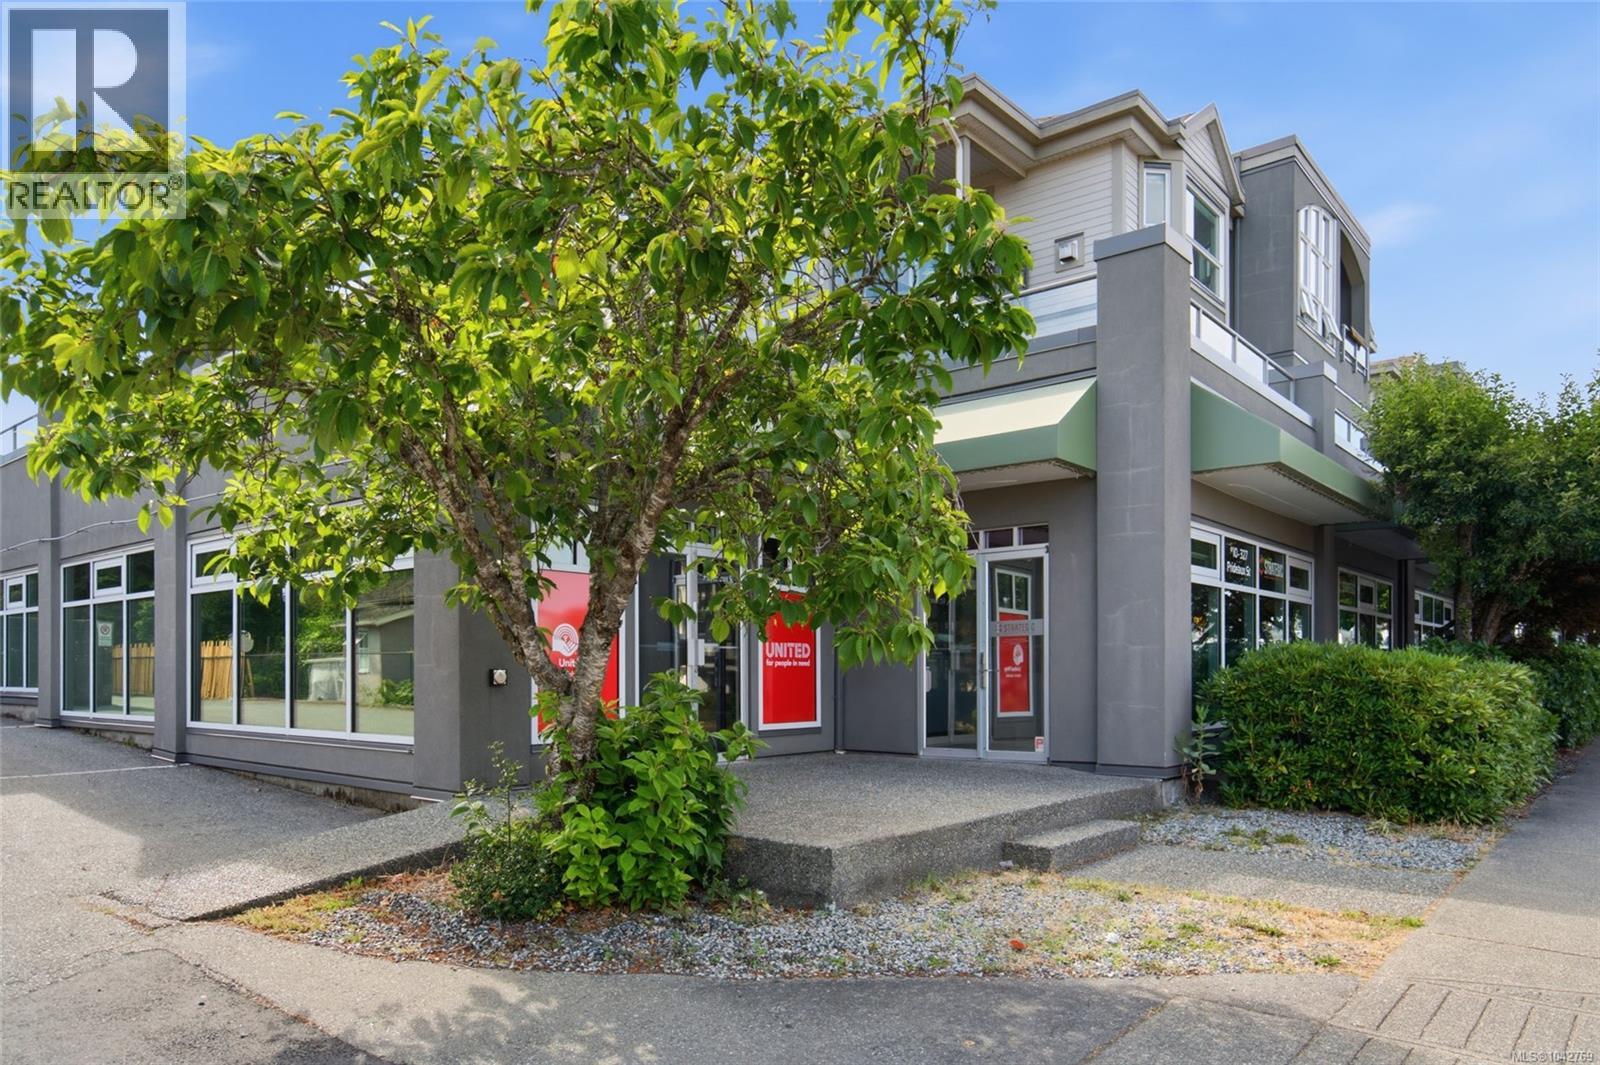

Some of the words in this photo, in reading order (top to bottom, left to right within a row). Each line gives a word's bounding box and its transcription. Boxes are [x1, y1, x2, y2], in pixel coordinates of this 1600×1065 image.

[766, 642, 811, 658] UNITED
[558, 658, 576, 668] Unit
[766, 658, 774, 666] for
[774, 659, 792, 669] people
[798, 659, 811, 667] need
